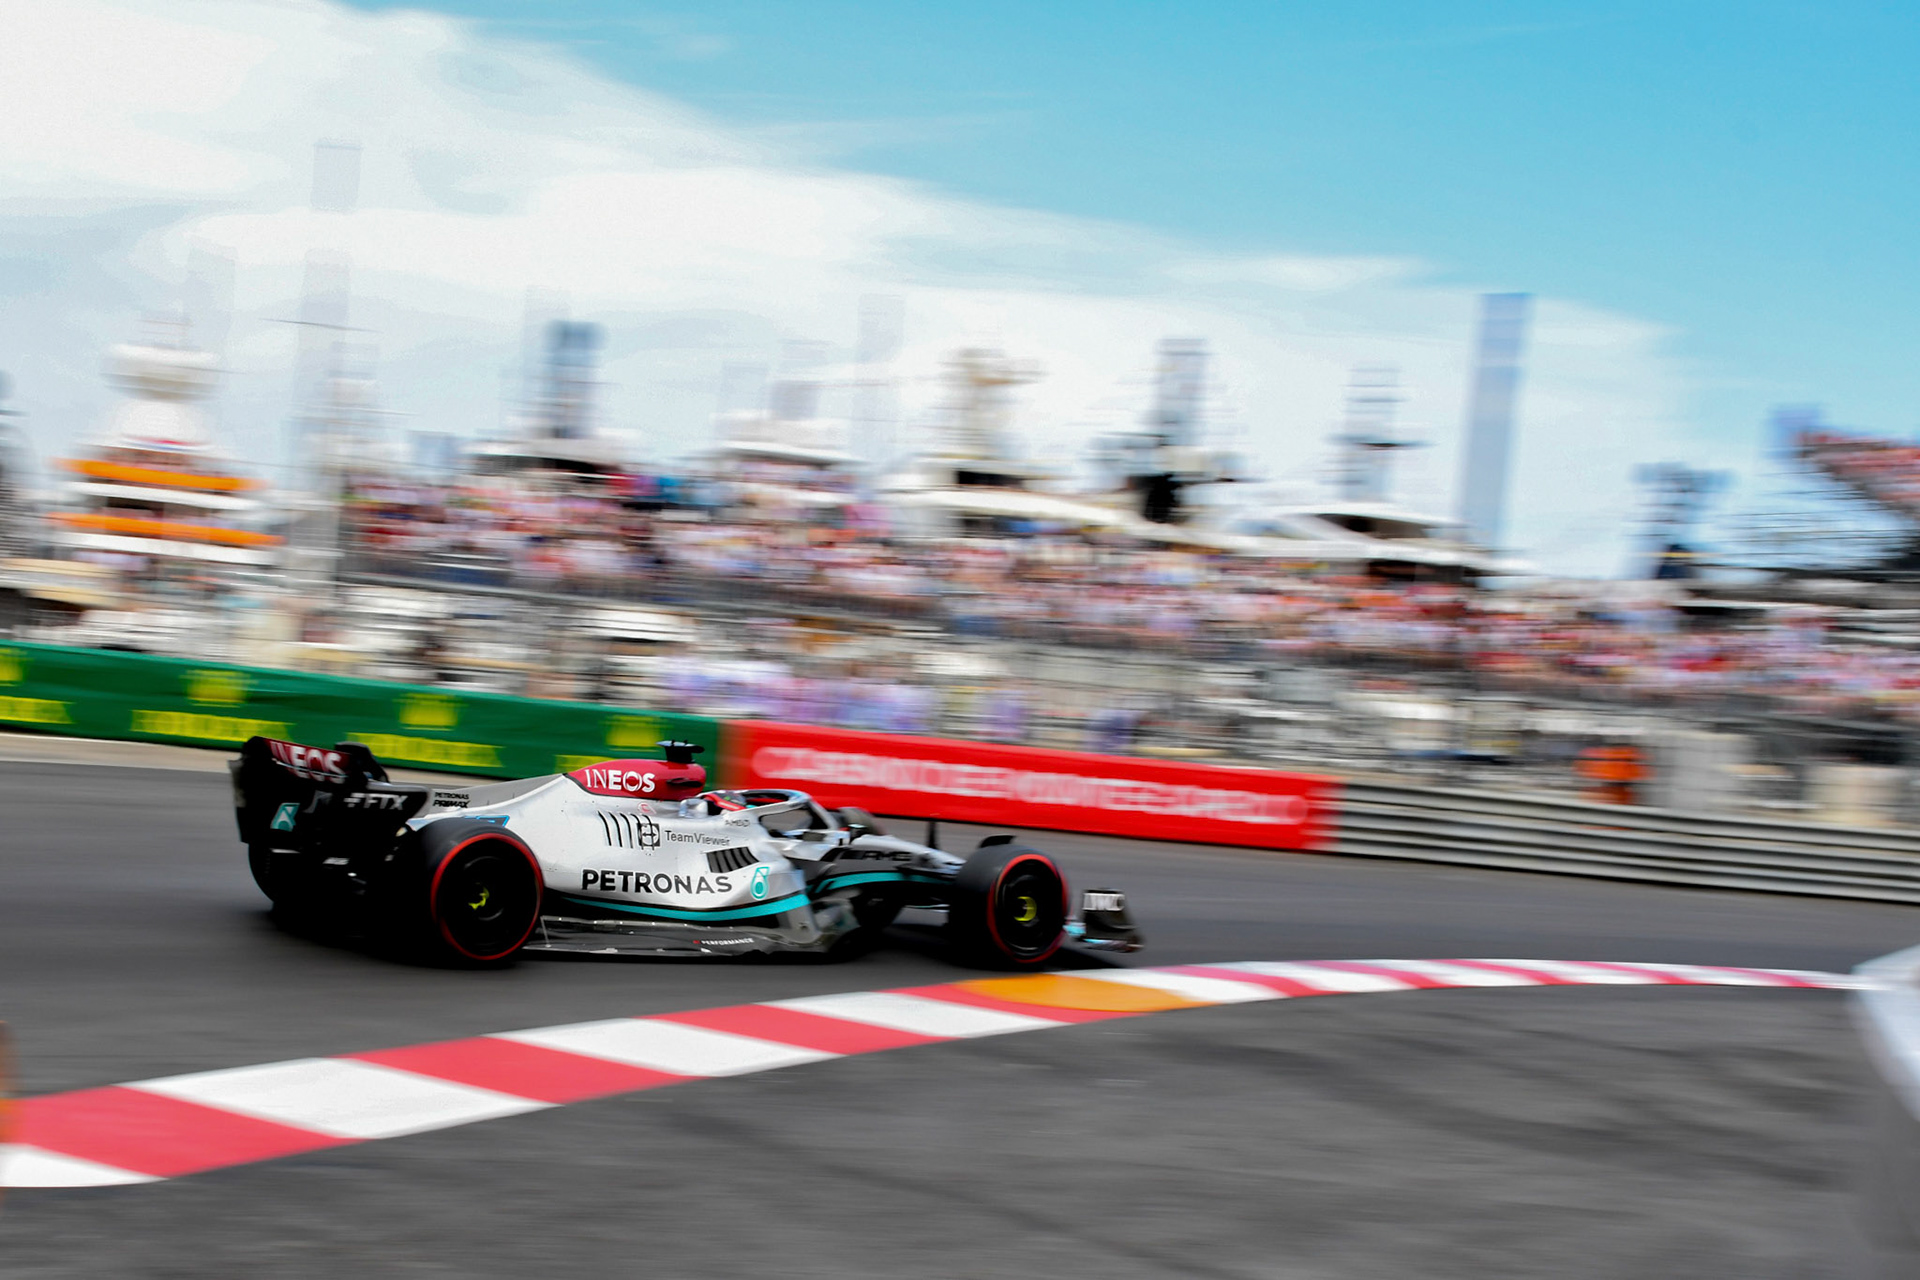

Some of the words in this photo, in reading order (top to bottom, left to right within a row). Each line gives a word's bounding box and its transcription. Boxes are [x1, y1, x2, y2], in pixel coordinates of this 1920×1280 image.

[270, 741, 346, 784] INEOS
[585, 768, 656, 793] INEOS
[364, 793, 408, 810] FTX
[434, 792, 470, 800] PETRONAS
[664, 830, 730, 846] TeamViewer
[582, 868, 732, 894] PETRONAS
